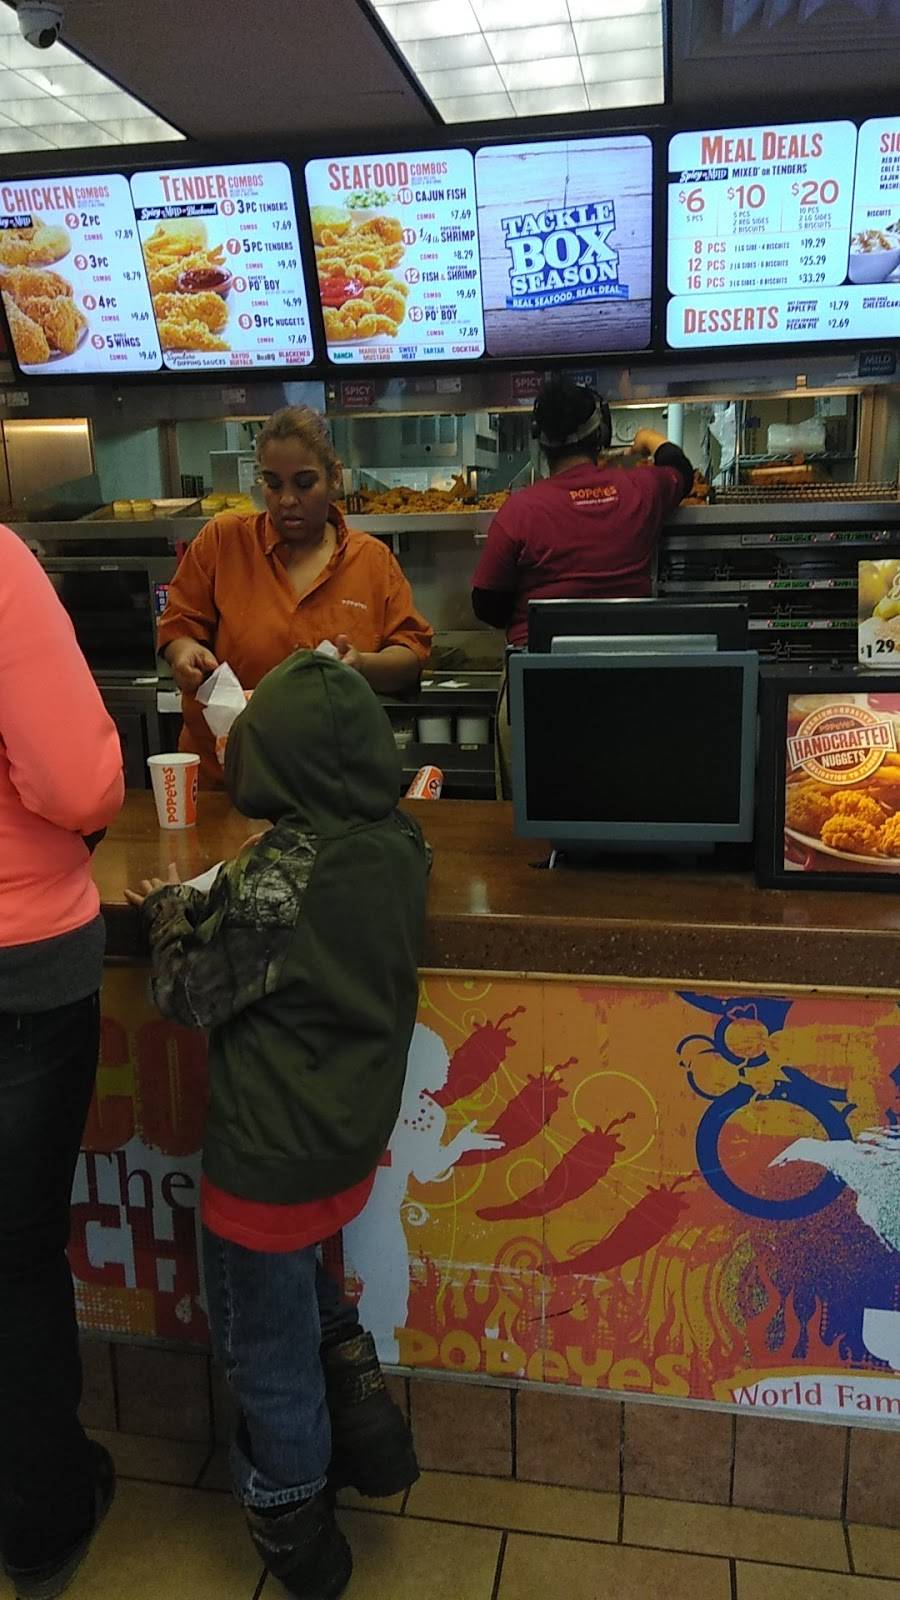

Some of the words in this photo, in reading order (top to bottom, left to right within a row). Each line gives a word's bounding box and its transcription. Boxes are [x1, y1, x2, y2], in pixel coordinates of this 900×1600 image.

[701, 134, 757, 165] MEAL
[762, 131, 823, 161] DEALS
[328, 162, 409, 191] SEAFOOD
[410, 162, 448, 175] COMBOS
[772, 164, 807, 176] TENDERS
[159, 174, 228, 202] TENDER
[228, 175, 264, 188] COMBOS
[415, 190, 444, 202] CAJUN
[446, 187, 466, 200] FISH
[678, 188, 705, 213] $6
[727, 184, 766, 210] $10
[791, 179, 840, 206] $20
[1, 185, 76, 213] CHICKEN
[75, 186, 110, 199] COMBOS
[259, 202, 288, 212] TENDERS
[451, 209, 471, 220] $7.69
[502, 201, 615, 239] TACKLE
[739, 225, 765, 233] BISCUITS
[804, 221, 831, 229] BISCUITS
[440, 230, 475, 243] SHRIMP
[229, 240, 237, 253] 7
[265, 241, 293, 251] TENDERS
[506, 222, 619, 277] BOX
[694, 240, 702, 254] 8
[707, 241, 726, 254] PCS
[766, 242, 790, 250] BISCUITS
[801, 237, 826, 249] $19.29
[688, 257, 702, 272] 12
[707, 259, 726, 271] PCS
[765, 259, 788, 268] BISCUITS
[800, 255, 826, 266] $25.29
[264, 279, 280, 290] BOY
[406, 269, 418, 283] 12
[422, 271, 439, 281] FISH
[447, 270, 477, 280] SHRIMP
[510, 260, 618, 297] SEASON
[687, 275, 701, 289] 16
[707, 277, 725, 288] PCS
[764, 277, 787, 285] BISCUITS
[799, 272, 826, 283] $33.29
[456, 288, 476, 299] $9.69
[513, 299, 533, 308] REAL
[576, 288, 597, 298] REAL
[275, 317, 305, 327] NUGGETS
[441, 309, 457, 320] BOY
[683, 305, 779, 335] DESSERTS
[114, 337, 141, 348] WINGS
[344, 385, 370, 395] SPICY
[514, 376, 543, 388] SPICY
[794, 725, 890, 761] HANDCRAFTED
[821, 749, 866, 768] NUGGETS
[80, 1150, 197, 1209] The
[728, 1381, 822, 1406] World
